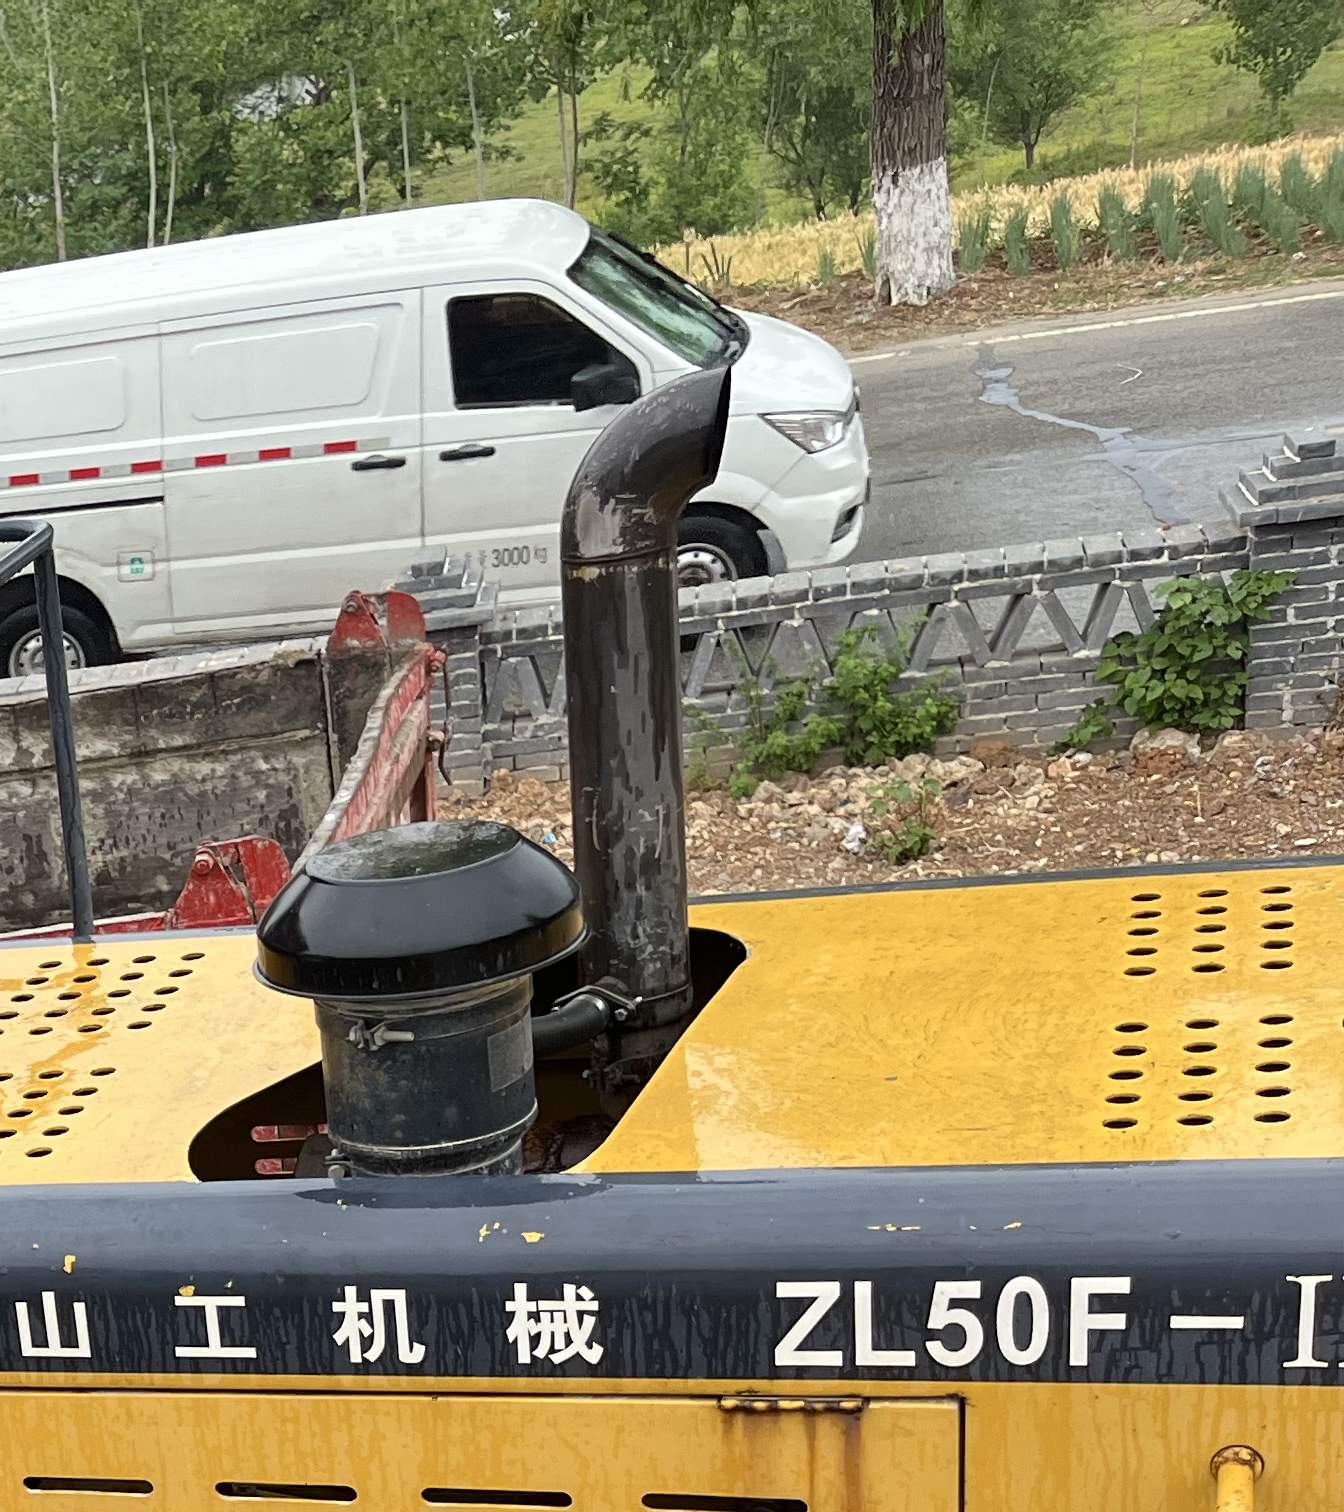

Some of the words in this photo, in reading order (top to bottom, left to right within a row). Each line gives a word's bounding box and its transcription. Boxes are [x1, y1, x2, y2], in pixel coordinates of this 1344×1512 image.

[491, 545, 531, 568] 3000
[14, 1281, 605, 1365] 山工机械
